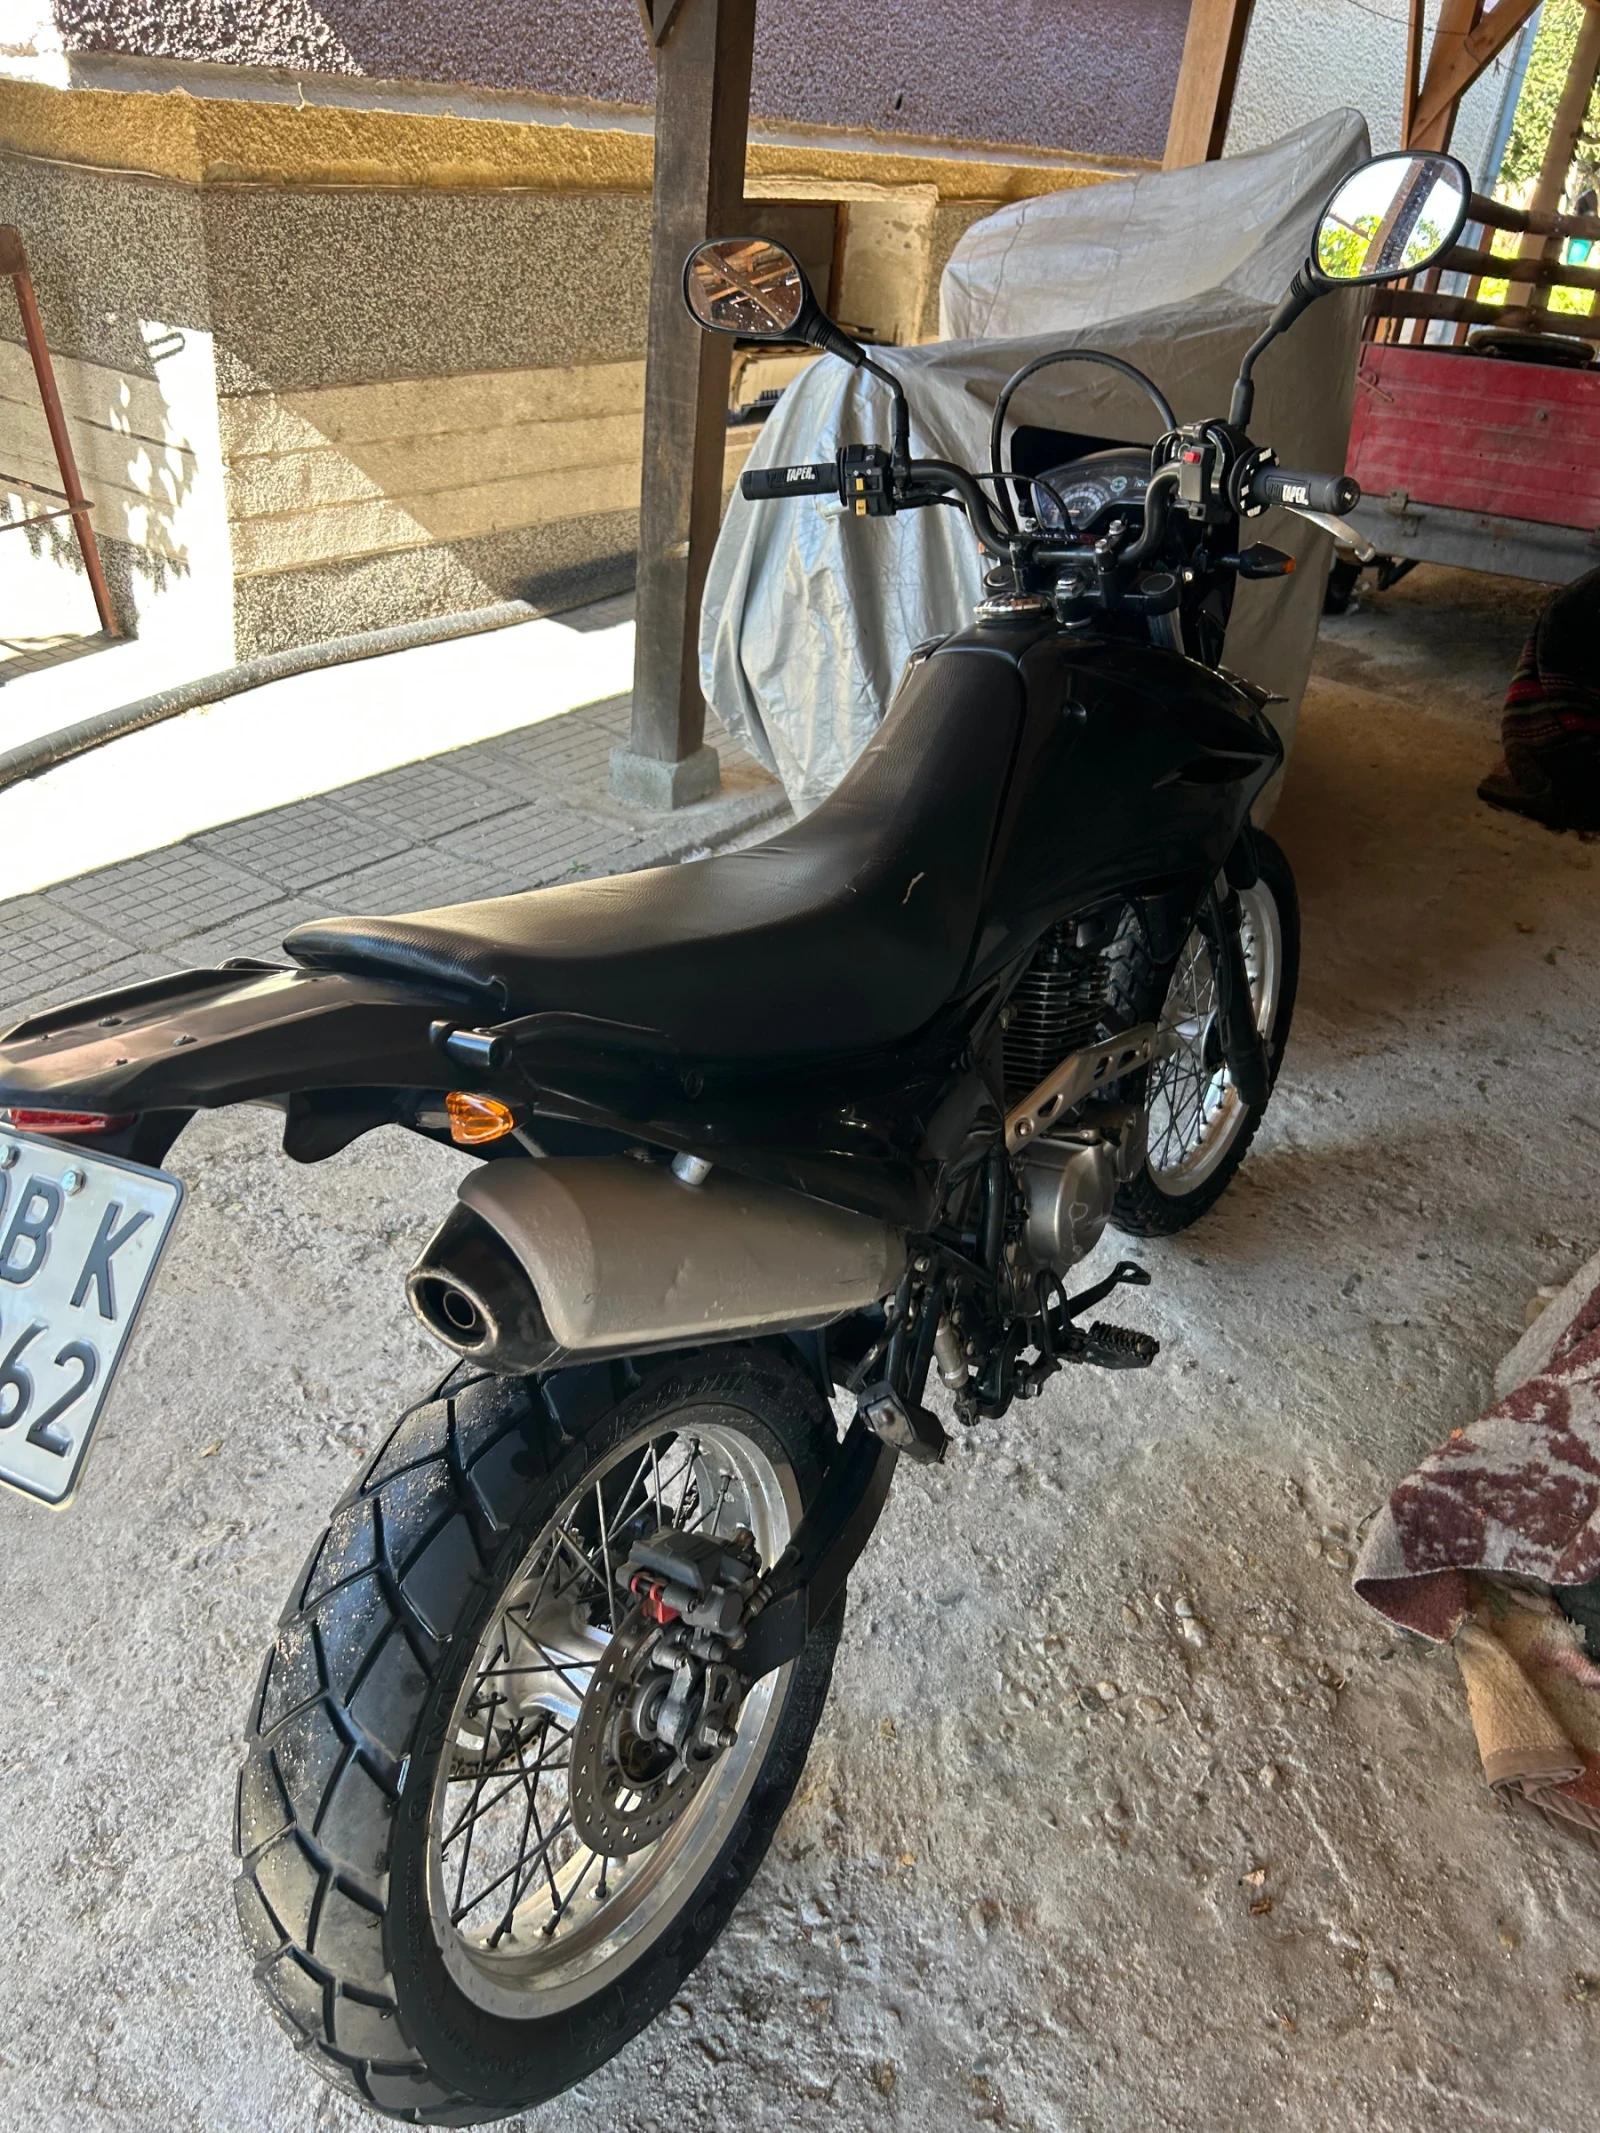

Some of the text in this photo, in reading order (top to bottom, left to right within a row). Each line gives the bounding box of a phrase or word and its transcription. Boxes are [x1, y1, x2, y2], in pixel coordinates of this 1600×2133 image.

[0, 1170, 150, 1320] B K
[0, 1321, 97, 1458] 62
